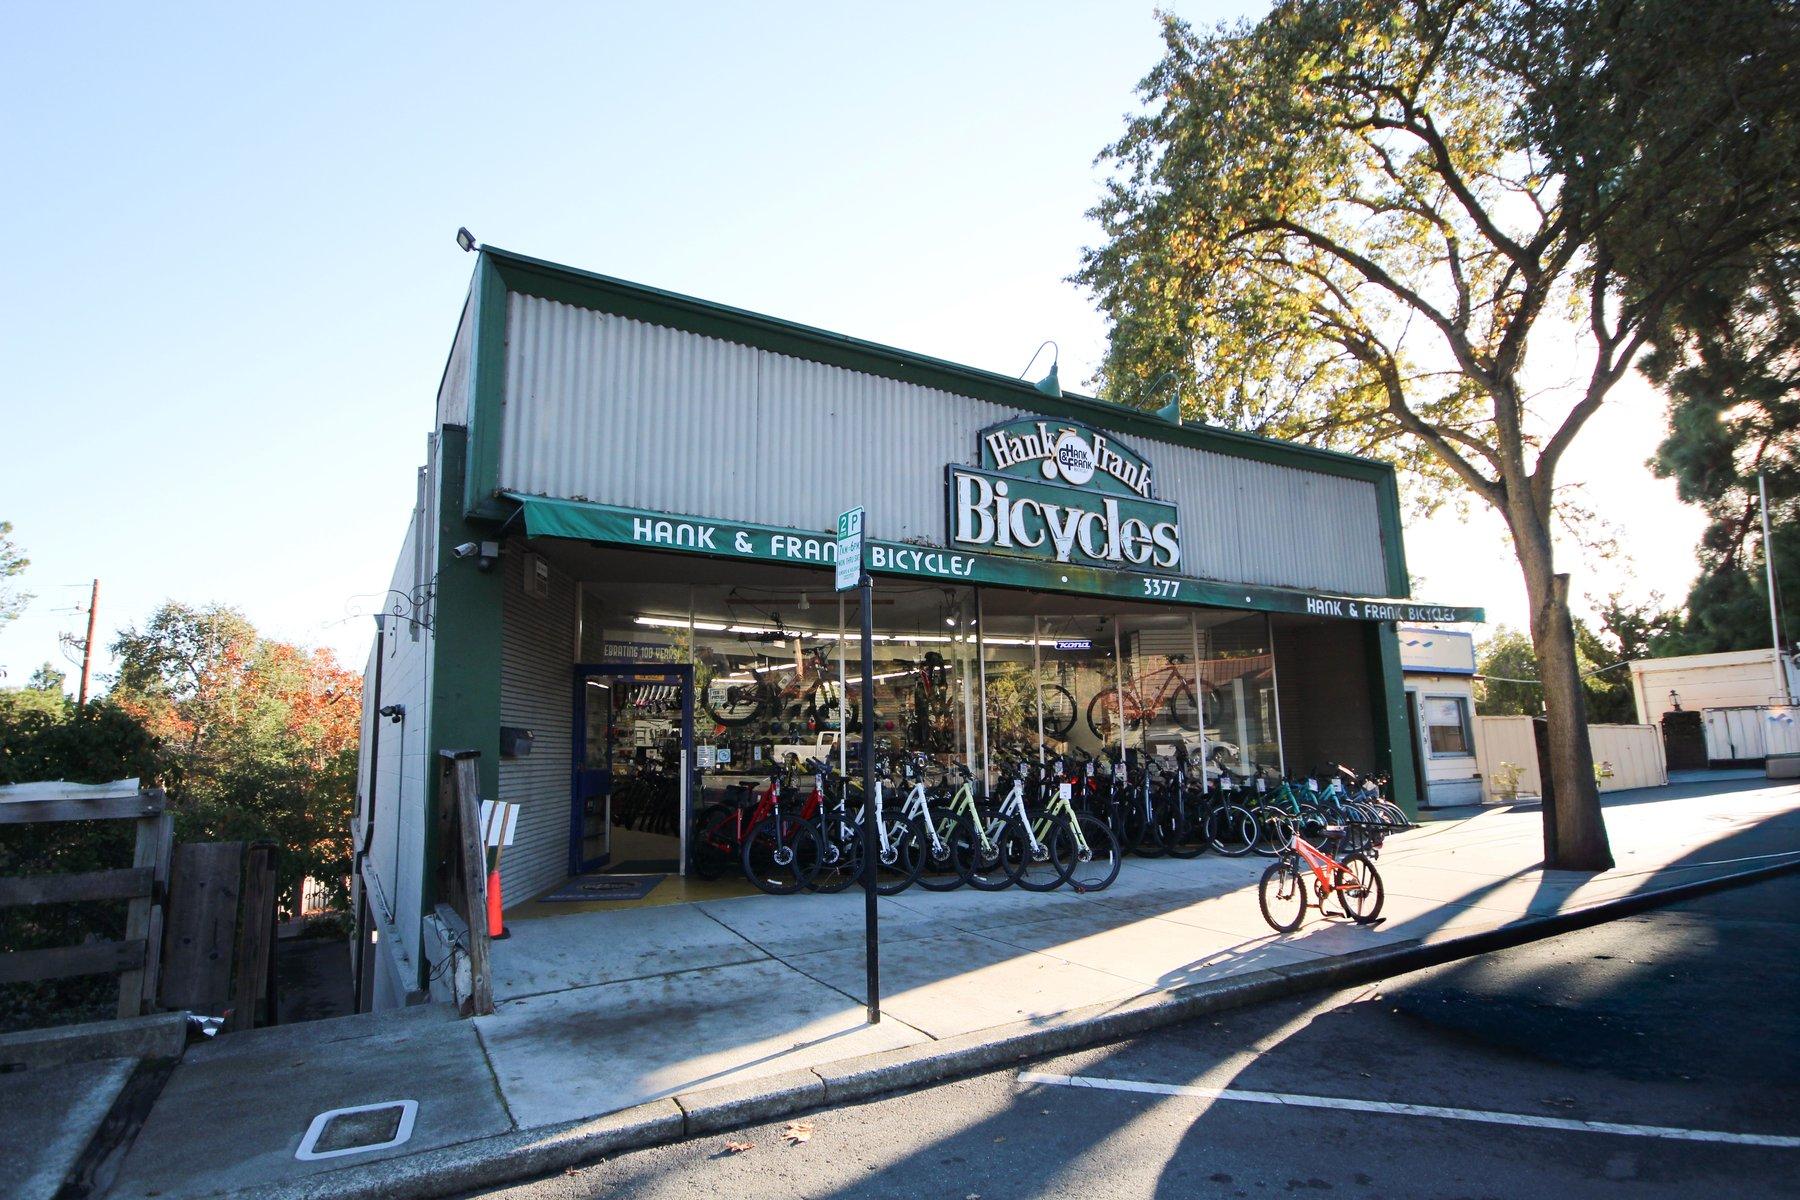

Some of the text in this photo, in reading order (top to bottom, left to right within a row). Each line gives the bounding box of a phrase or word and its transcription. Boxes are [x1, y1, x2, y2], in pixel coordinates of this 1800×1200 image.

[985, 422, 1152, 498] Hank Frank
[841, 514, 858, 532] 2 P
[954, 472, 1181, 568] Bicycles
[633, 517, 716, 550] HANK
[735, 531, 753, 554] &
[771, 535, 838, 563] FRAN
[872, 546, 975, 576] BICYCLES
[1143, 578, 1180, 598] 3377
[1307, 597, 1456, 622] HANK & FRANK BICYCLES
